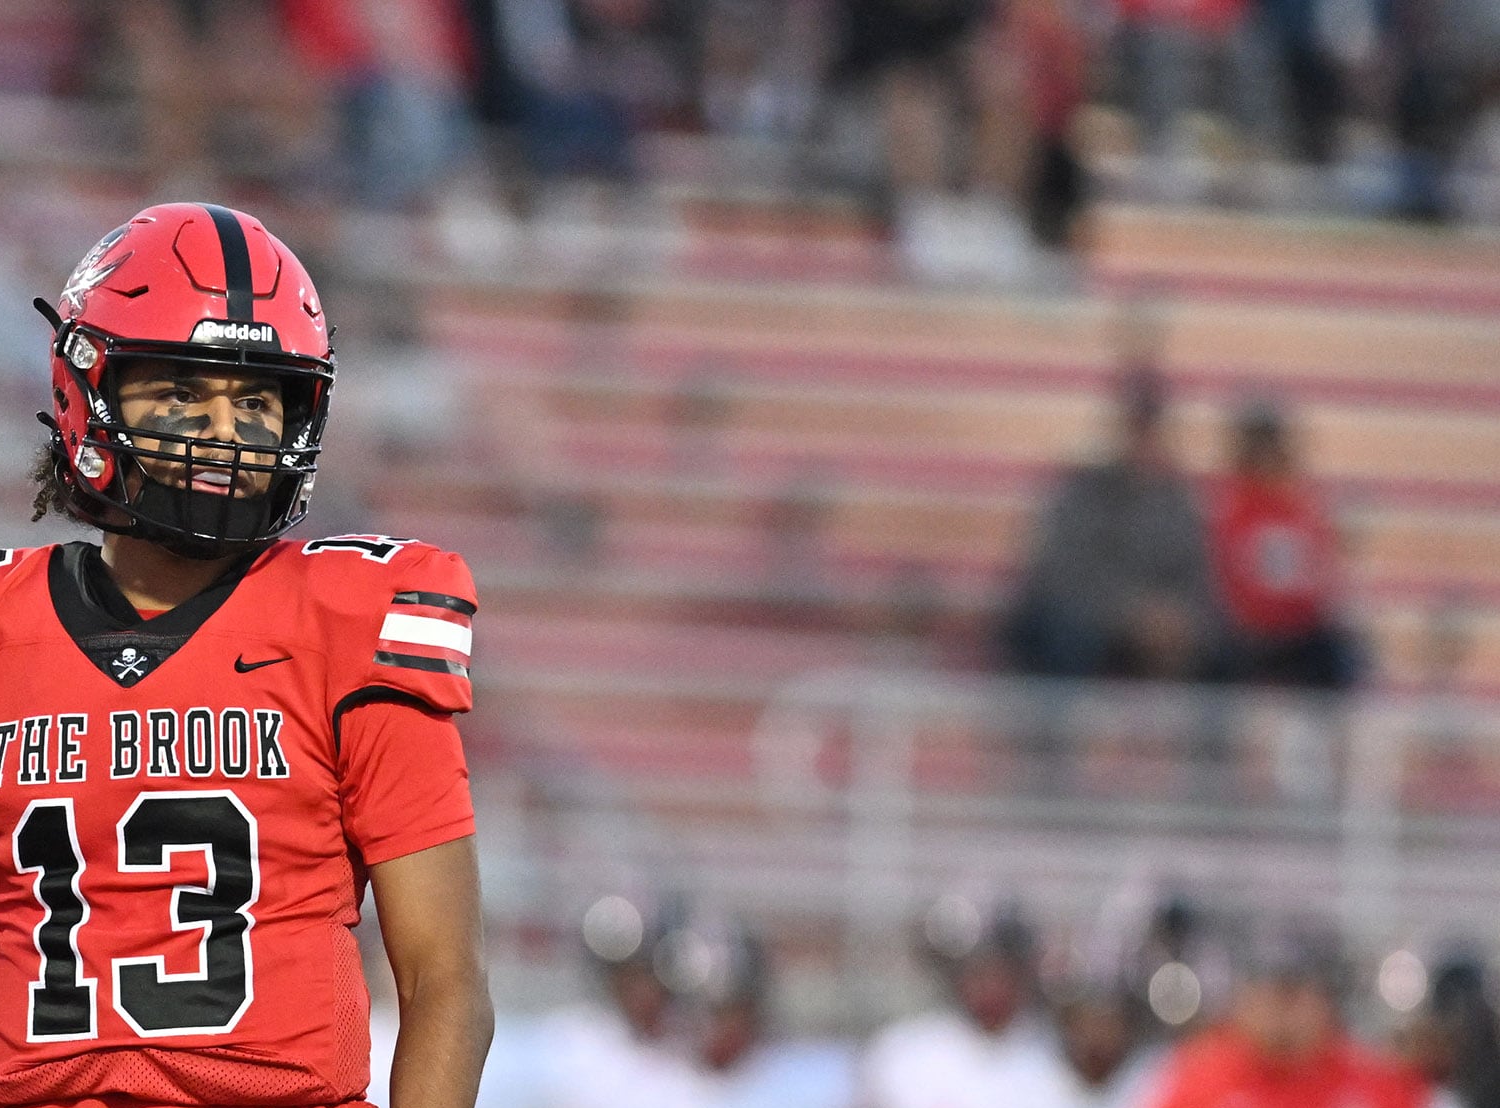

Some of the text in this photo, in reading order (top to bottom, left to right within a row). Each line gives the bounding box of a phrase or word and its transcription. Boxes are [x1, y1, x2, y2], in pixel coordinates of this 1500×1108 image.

[201, 320, 273, 342] Riddell
[109, 706, 290, 780] BROOK
[12, 789, 261, 1043] 13
